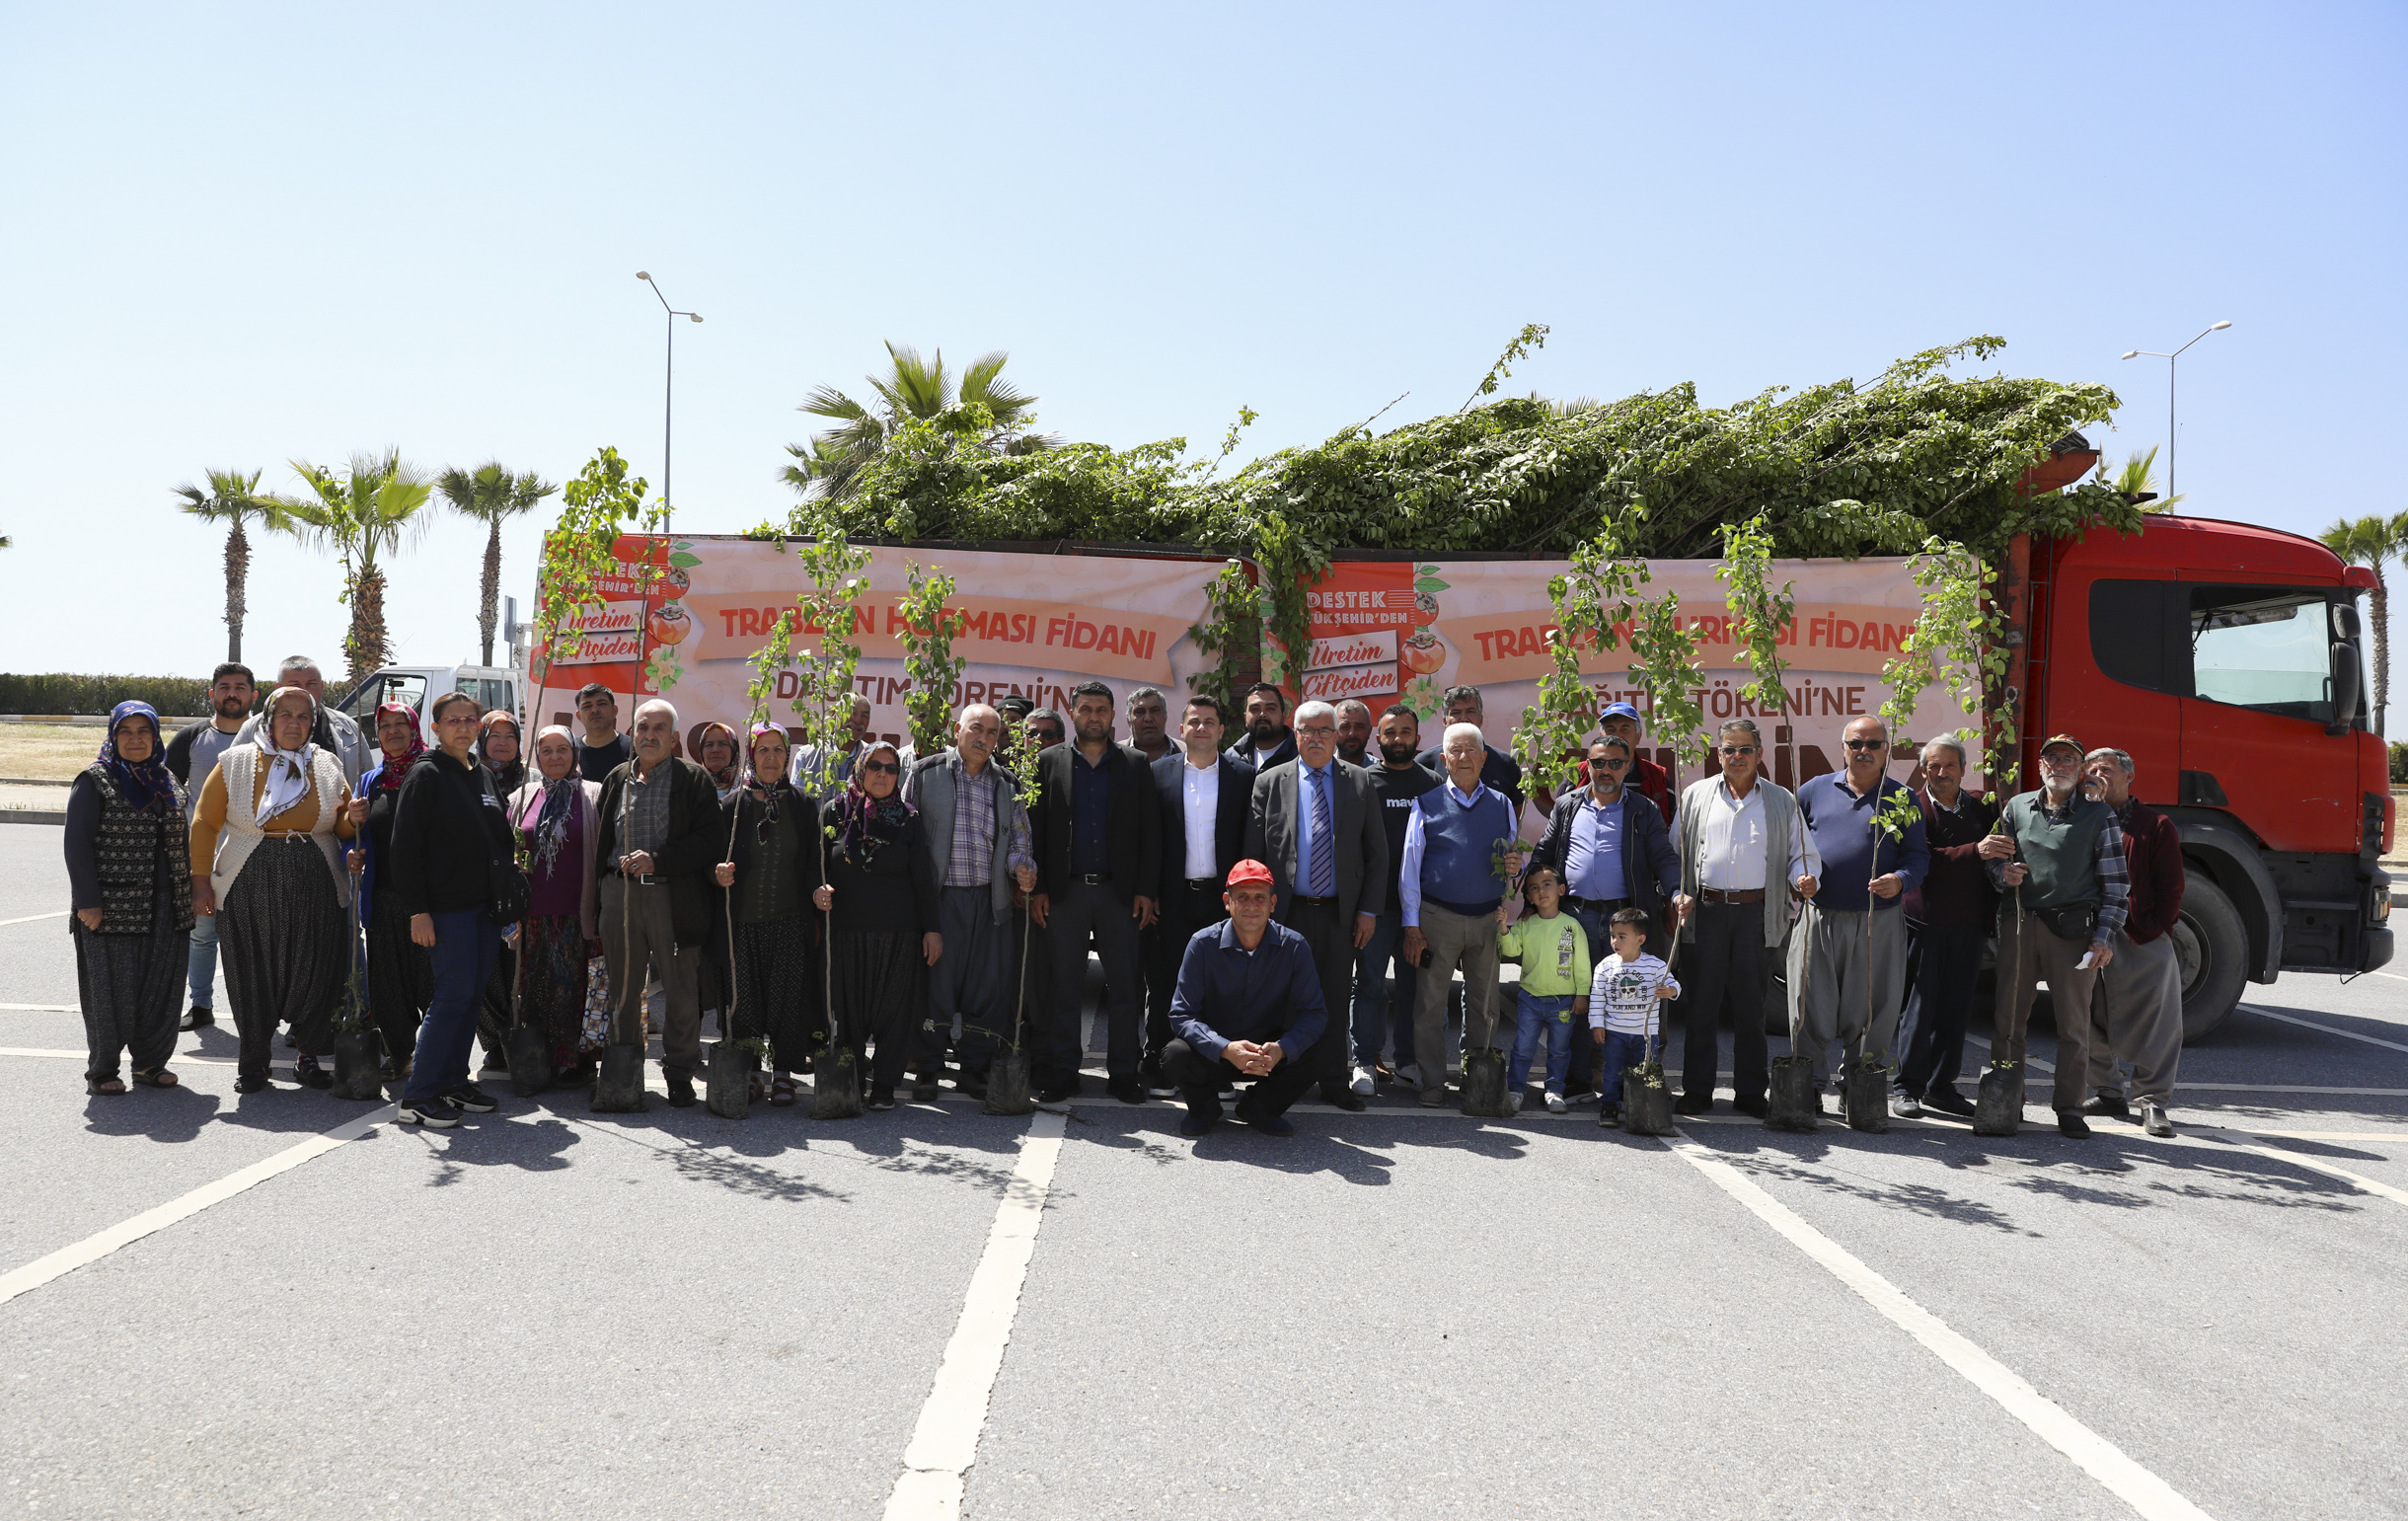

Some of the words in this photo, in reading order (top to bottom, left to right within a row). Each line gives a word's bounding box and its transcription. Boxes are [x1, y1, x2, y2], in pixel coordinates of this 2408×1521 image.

[1307, 591, 1387, 608] DESTEK
[1302, 611, 1407, 627] ÜKŞEHİR'DEN
[1647, 615, 1798, 646] URMSI
[719, 606, 875, 637] TRABZN
[1046, 612, 1157, 660] FİDANI
[1312, 641, 1384, 667] Üretim
[1304, 669, 1396, 701] Çiftçiden
[1386, 796, 1418, 807] mav
